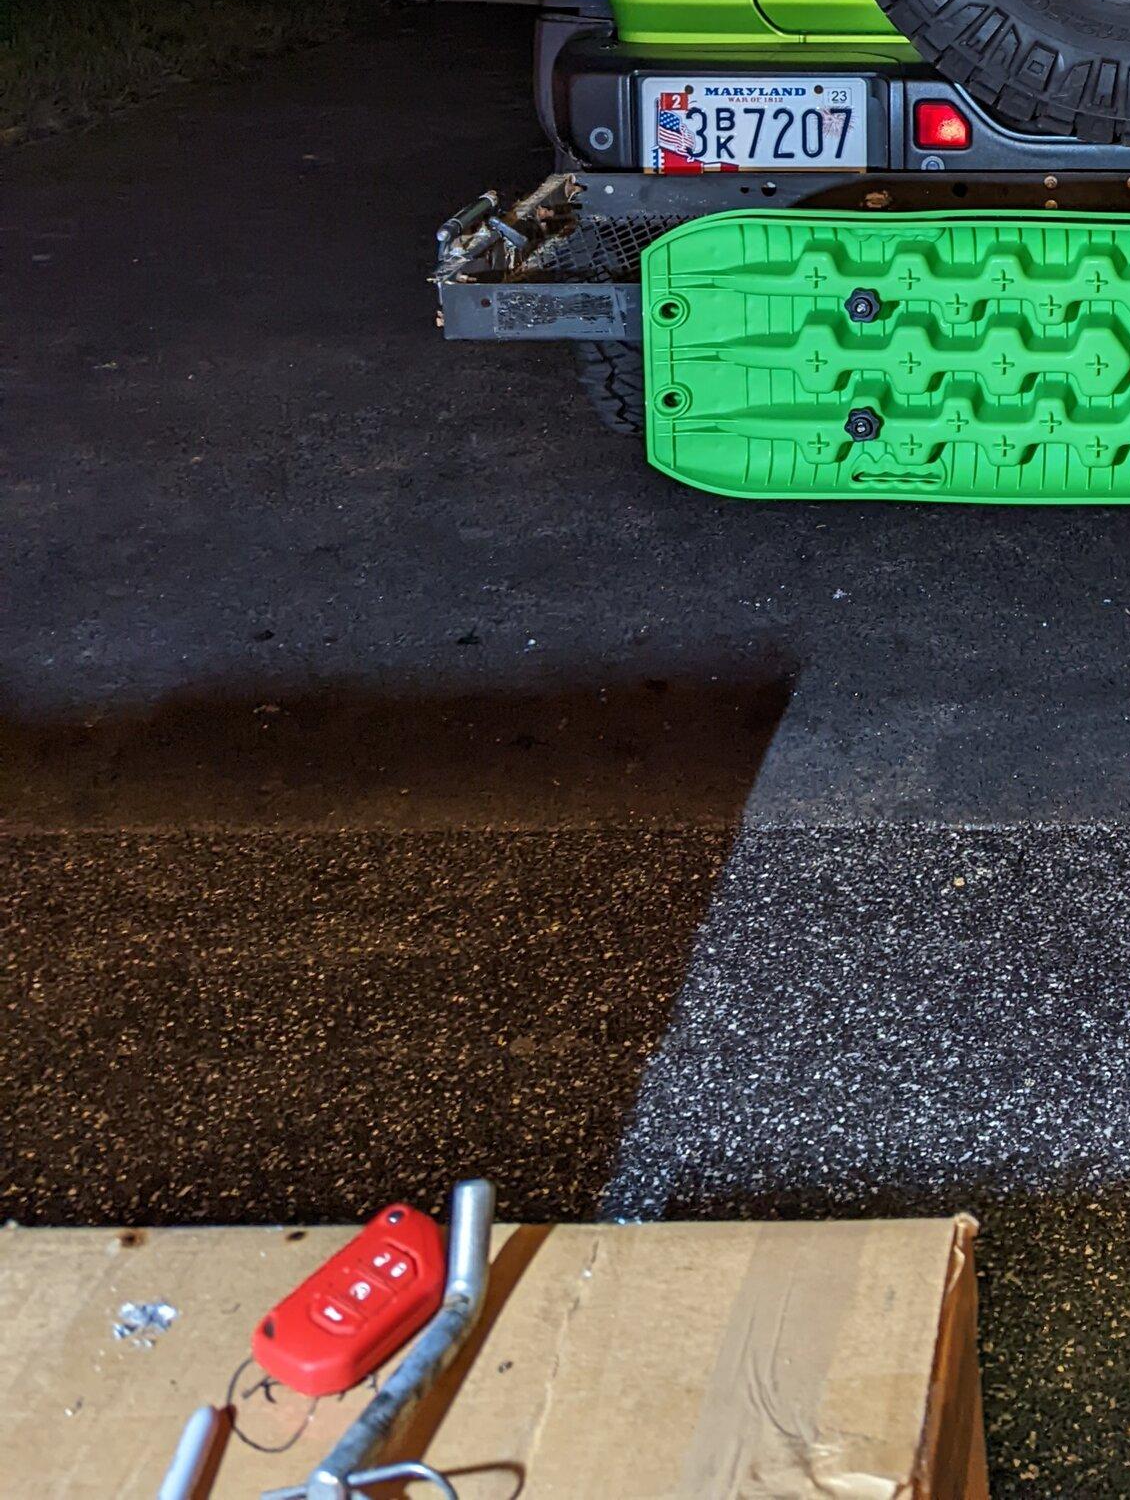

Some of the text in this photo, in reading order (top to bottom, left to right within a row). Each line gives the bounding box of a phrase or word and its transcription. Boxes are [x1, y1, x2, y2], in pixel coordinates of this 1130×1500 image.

[704, 86, 807, 97] MARYLAND
[831, 90, 848, 102] 23
[671, 94, 681, 109] 2
